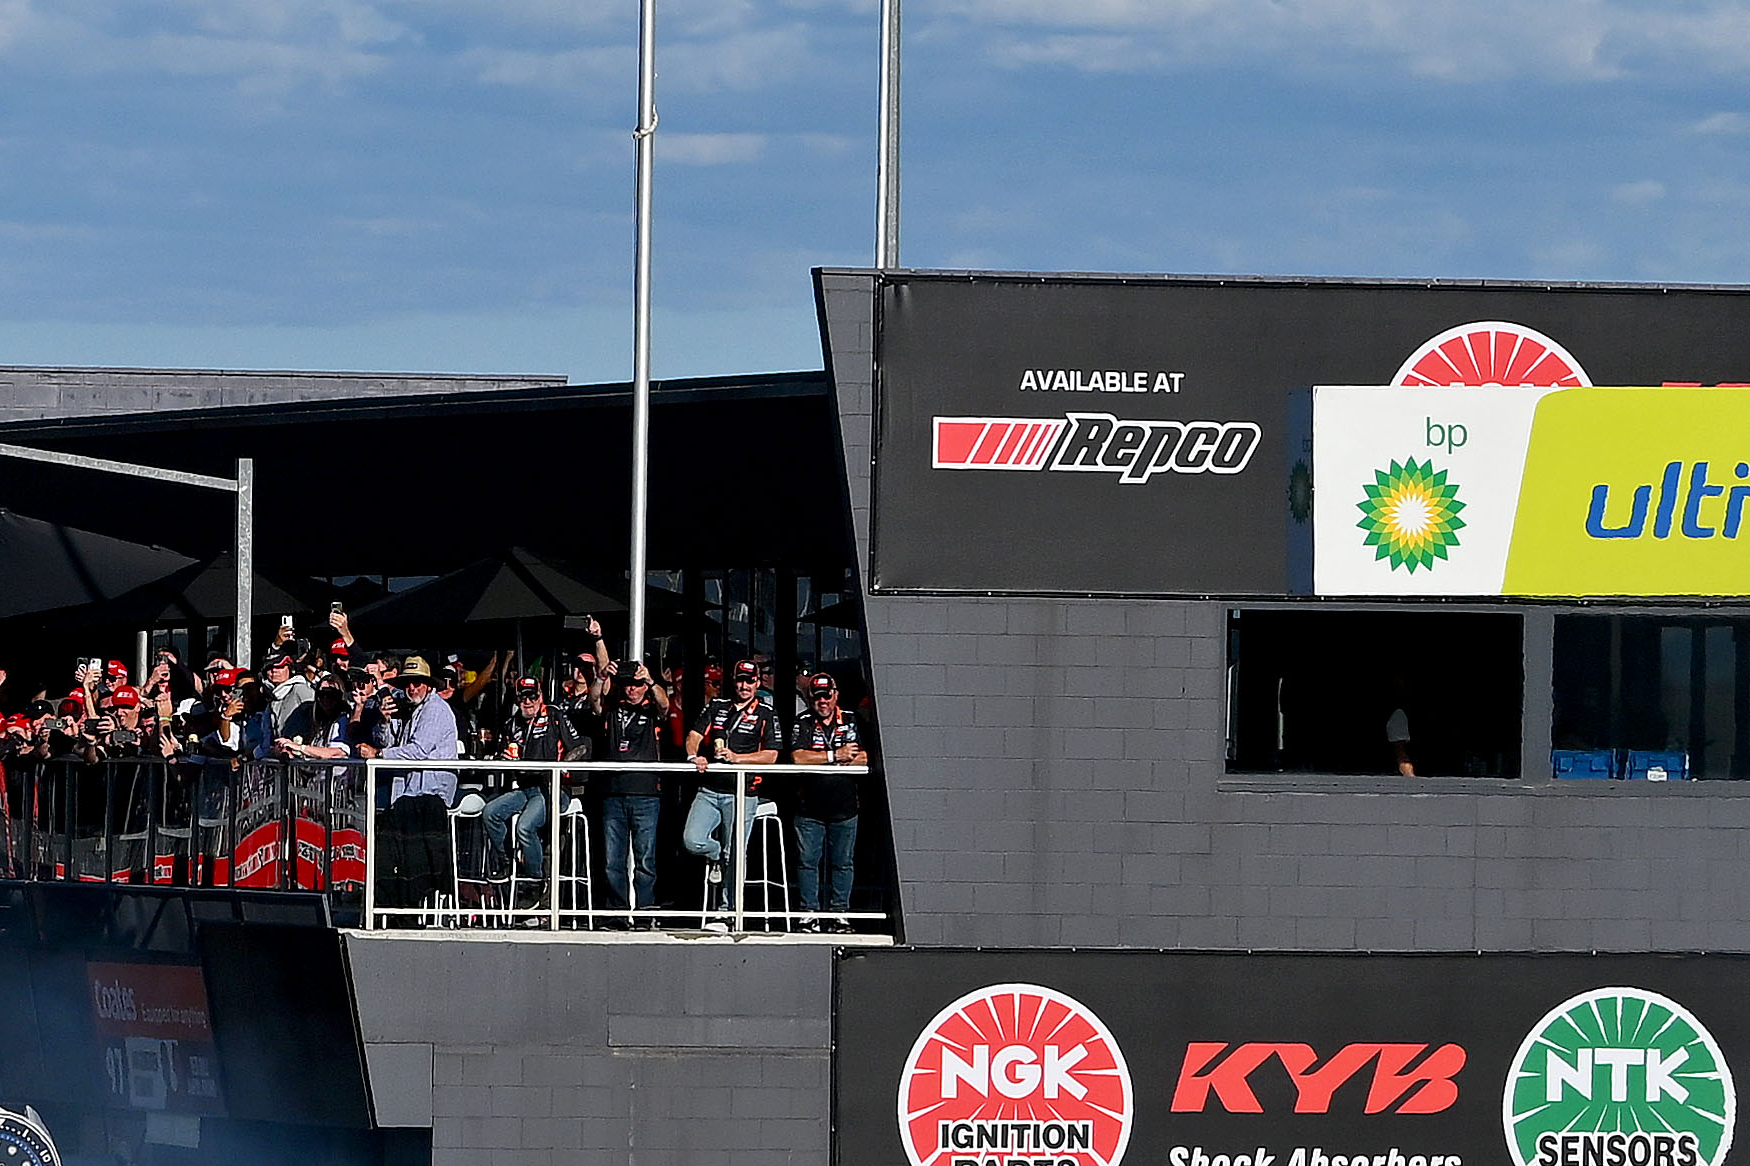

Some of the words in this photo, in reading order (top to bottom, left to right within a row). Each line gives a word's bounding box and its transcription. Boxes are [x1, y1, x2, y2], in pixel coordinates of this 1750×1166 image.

[1020, 370, 1147, 393] AVAILABLE
[1152, 371, 1185, 393] AT
[1053, 413, 1261, 482] Repco
[1425, 416, 1469, 454] bp
[940, 1043, 1090, 1100] NGK
[1170, 1042, 1466, 1114] KYB
[1546, 1047, 1691, 1102] NTK
[941, 1121, 1090, 1153] IGNITION
